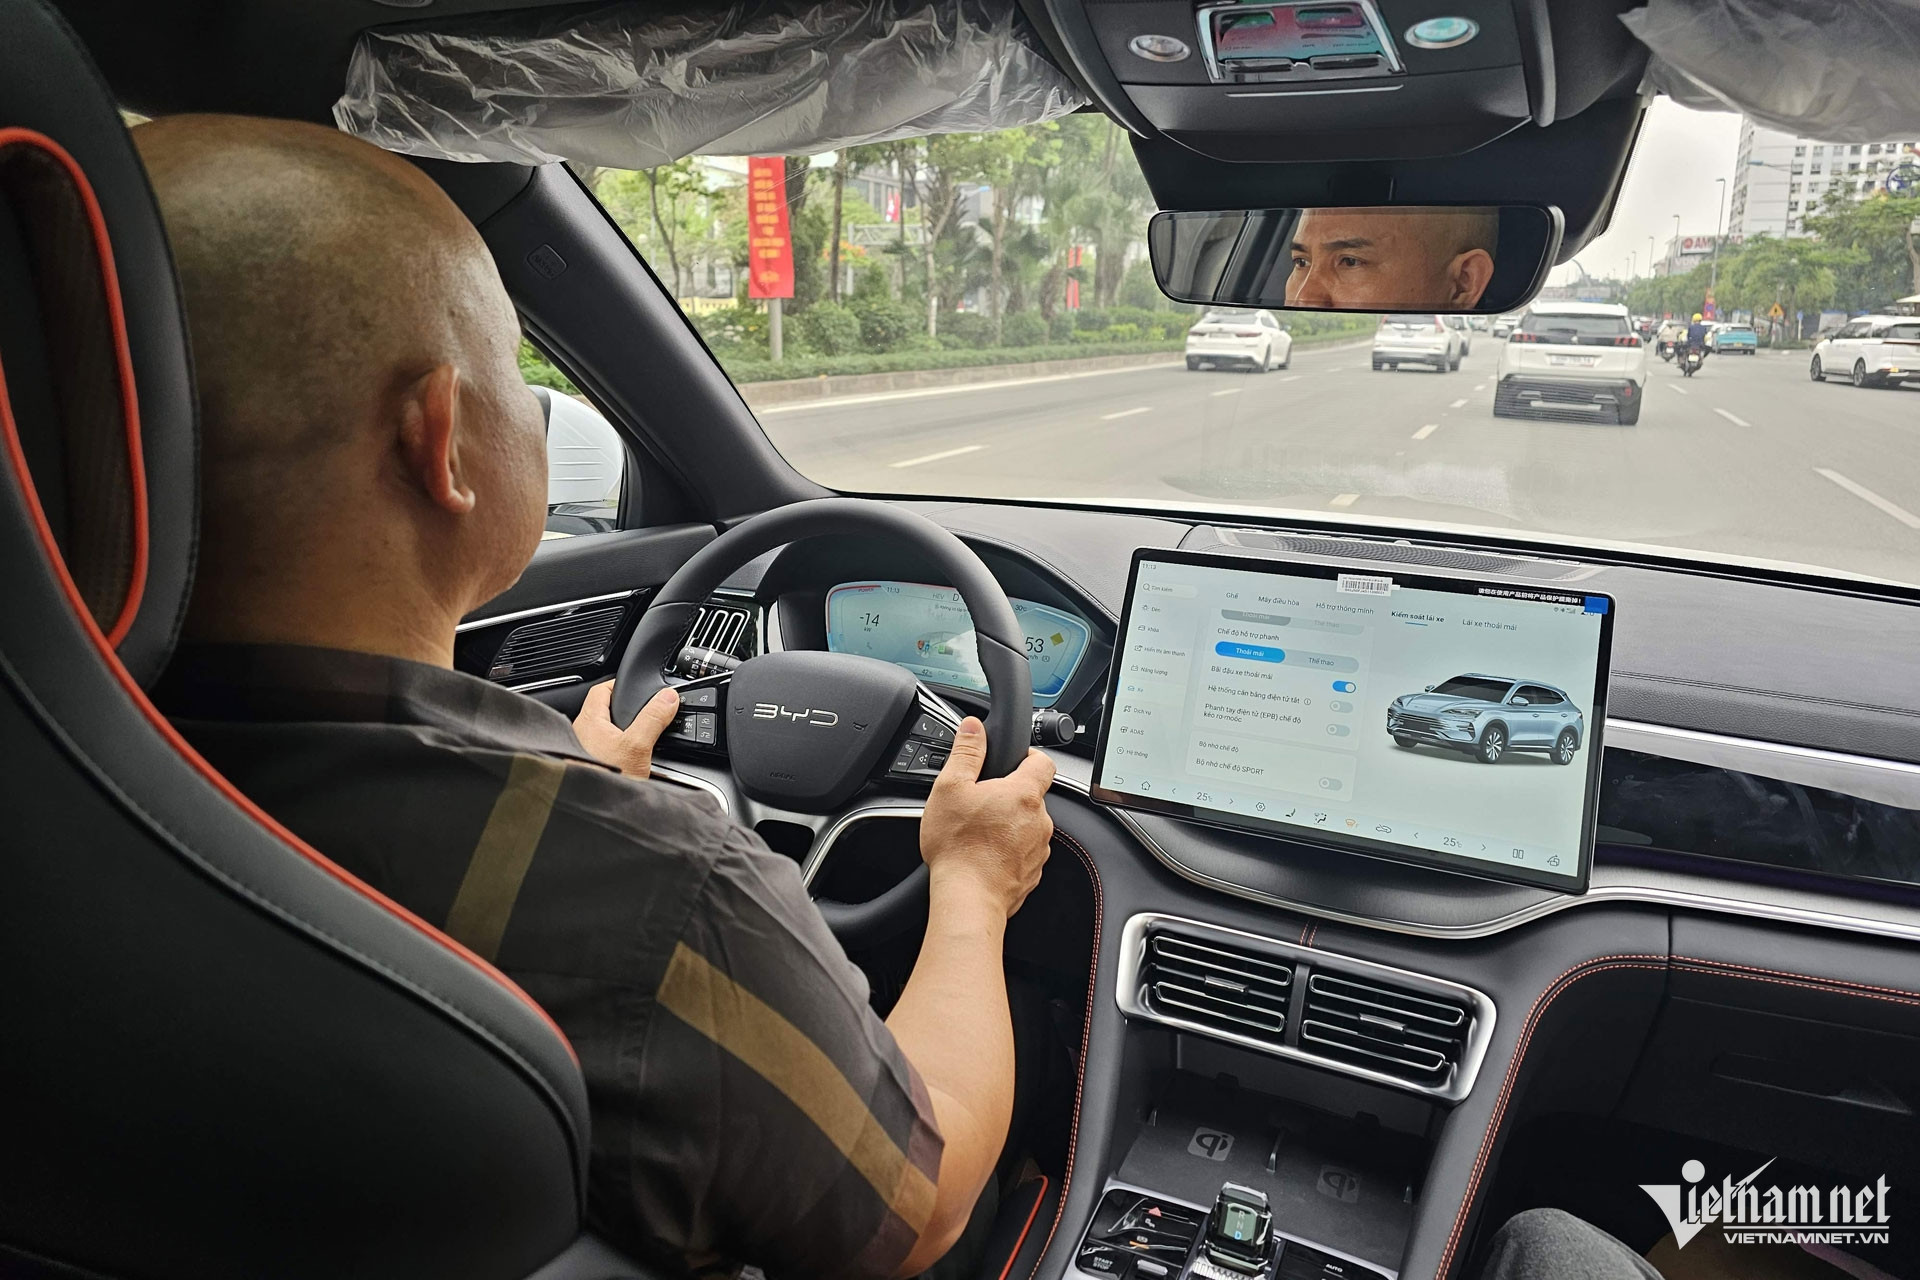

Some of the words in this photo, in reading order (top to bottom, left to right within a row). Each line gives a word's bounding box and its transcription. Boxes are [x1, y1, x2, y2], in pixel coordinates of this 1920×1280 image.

[952, 593, 960, 602] D
[1357, 606, 1374, 615] minh
[859, 613, 880, 627] -14
[1409, 613, 1425, 621] soát
[1503, 623, 1517, 631] mái
[1259, 633, 1280, 642] phanh
[1025, 636, 1045, 653] 53
[1320, 658, 1335, 666] thao
[753, 703, 839, 726] BYD
[1203, 711, 1215, 719] kéo
[1205, 703, 1225, 712] Phanh
[1225, 705, 1236, 714] tay
[1259, 710, 1279, 720] (EPB)
[1241, 766, 1265, 775] SPORT
[1233, 1230, 1242, 1240] D
[1325, 1263, 1344, 1273] AUTO
